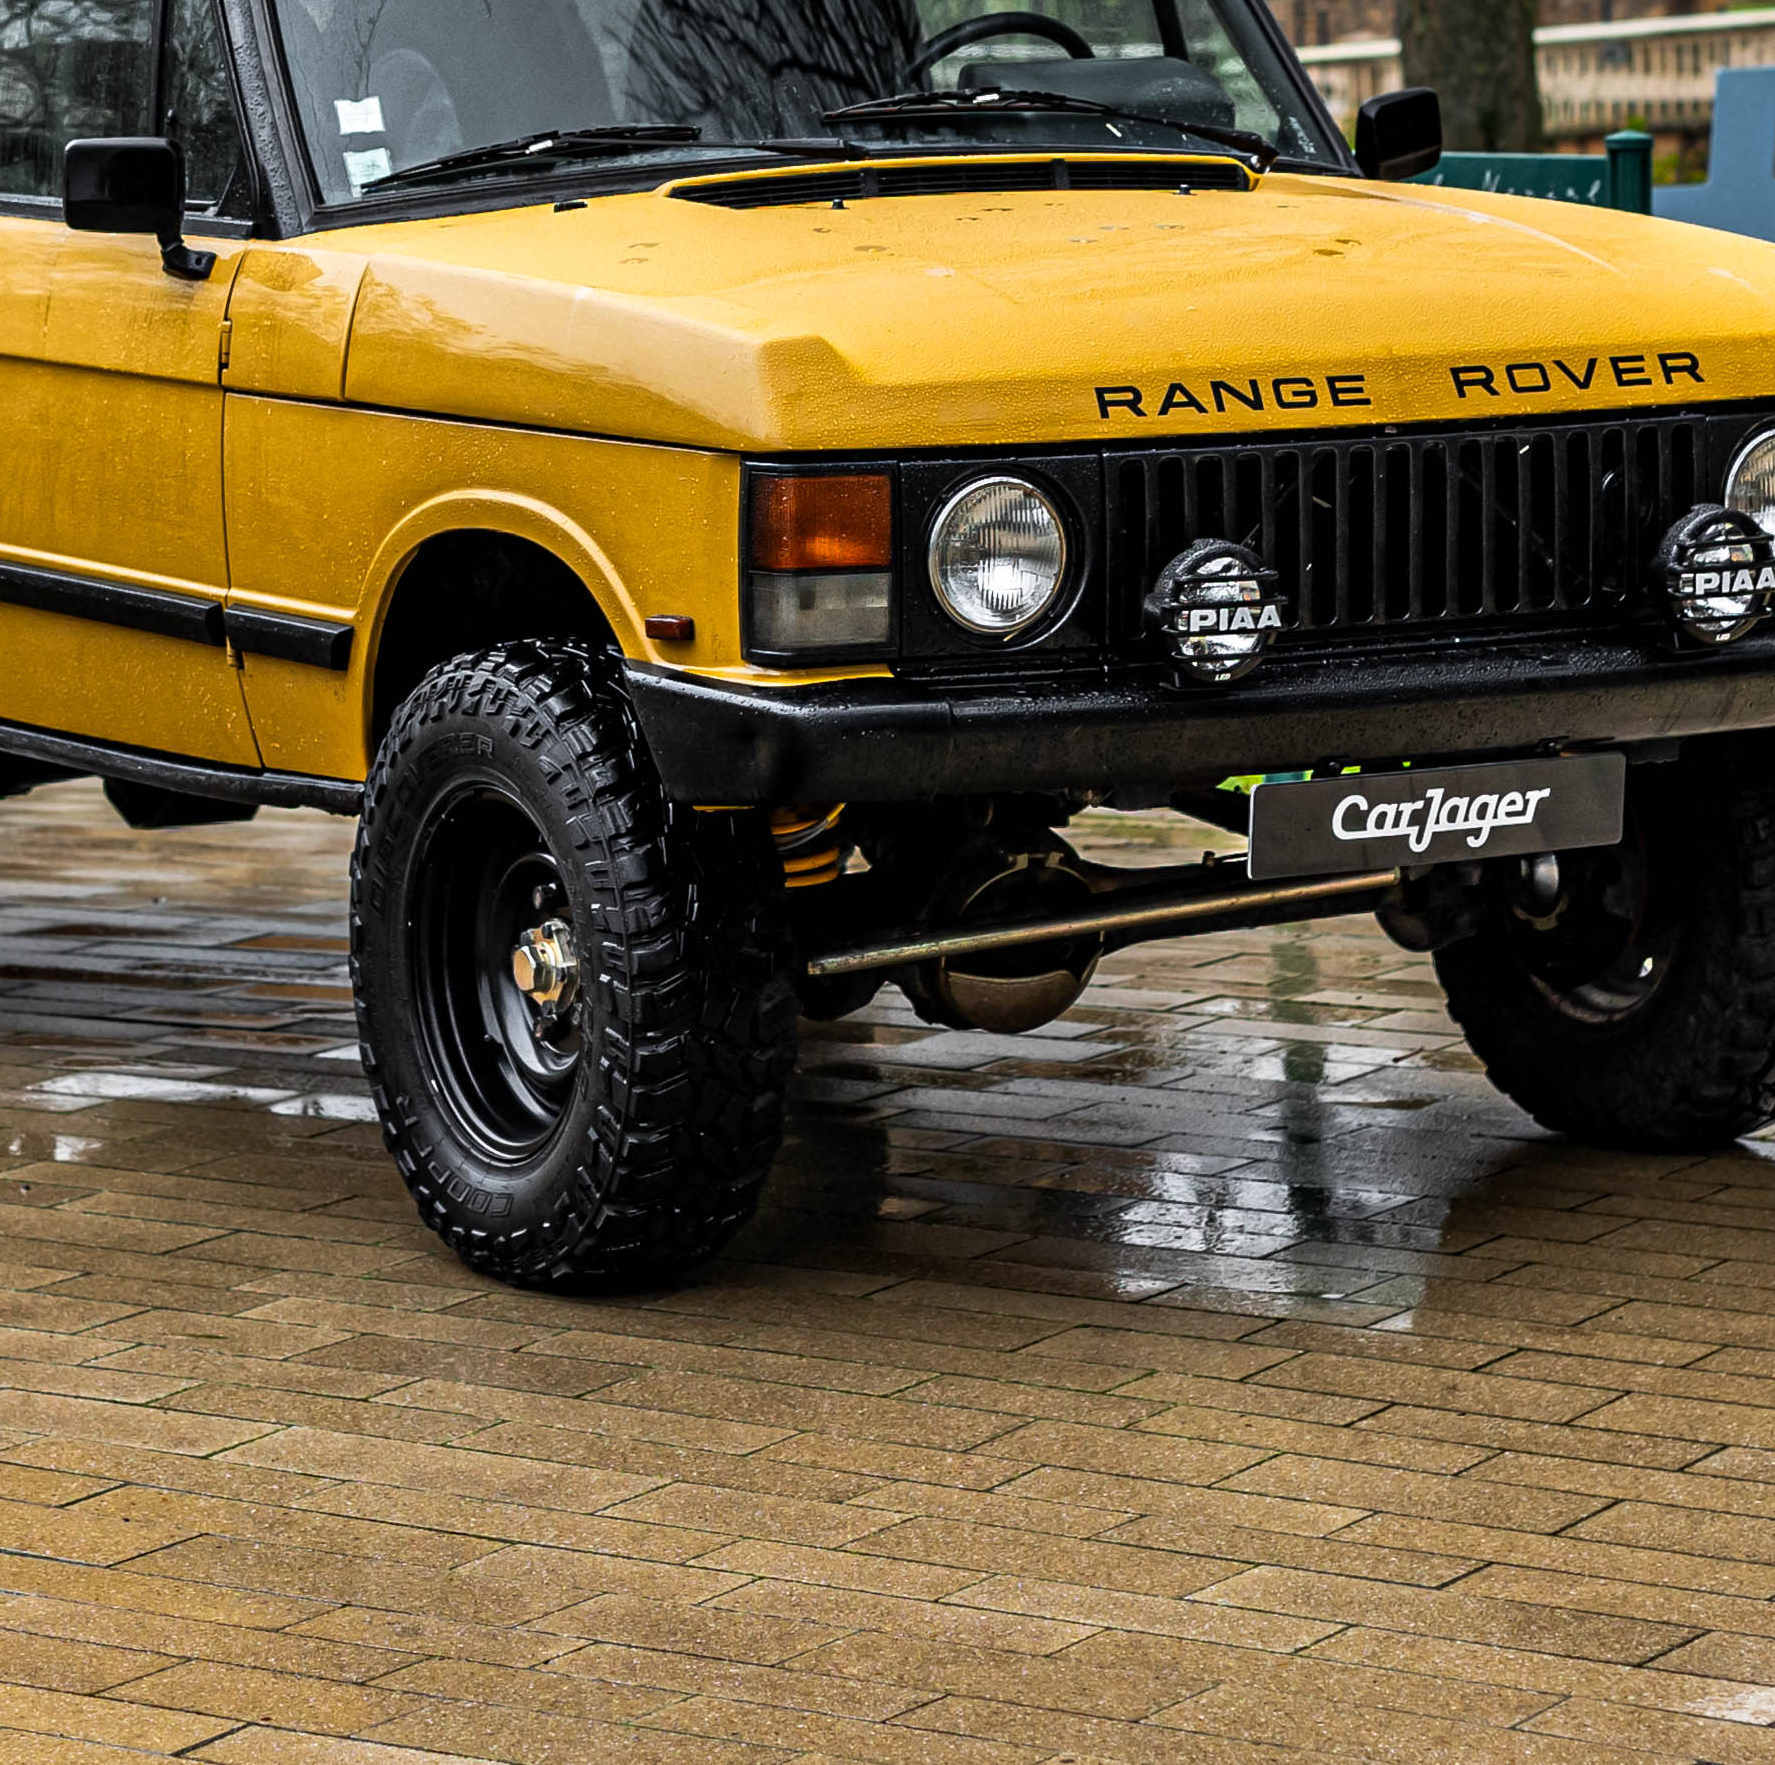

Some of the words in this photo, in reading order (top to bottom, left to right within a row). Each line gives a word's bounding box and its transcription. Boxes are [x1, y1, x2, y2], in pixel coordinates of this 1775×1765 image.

[1094, 374, 1372, 419] RANGE
[1449, 351, 1706, 399] ROVER
[1189, 604, 1282, 632] PIAA
[1331, 787, 1551, 853] CarJager
